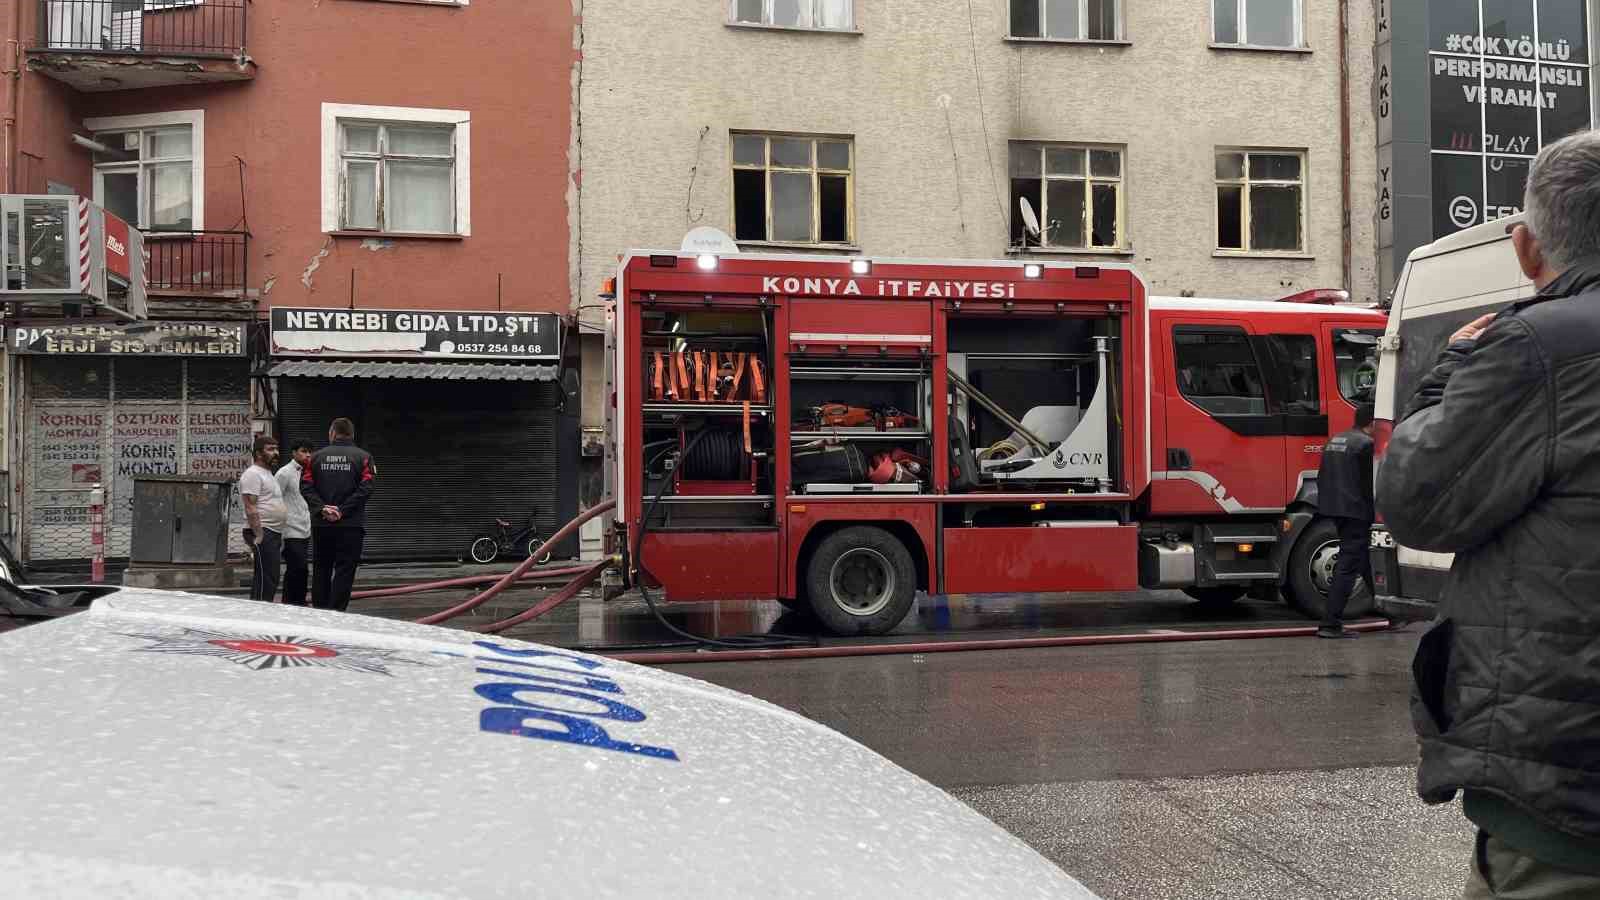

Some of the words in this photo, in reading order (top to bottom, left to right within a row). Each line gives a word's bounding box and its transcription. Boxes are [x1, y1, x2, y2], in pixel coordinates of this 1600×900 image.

[1434, 58, 1582, 86] PERFORMANSLI
[1490, 87, 1557, 109] RAHAT
[763, 277, 862, 295] KONYA
[395, 314, 450, 332] GIDA
[457, 343, 484, 353] 0537
[487, 344, 508, 353] 254
[511, 344, 525, 353] 84
[528, 345, 542, 354] 68
[1069, 452, 1103, 465] CNR
